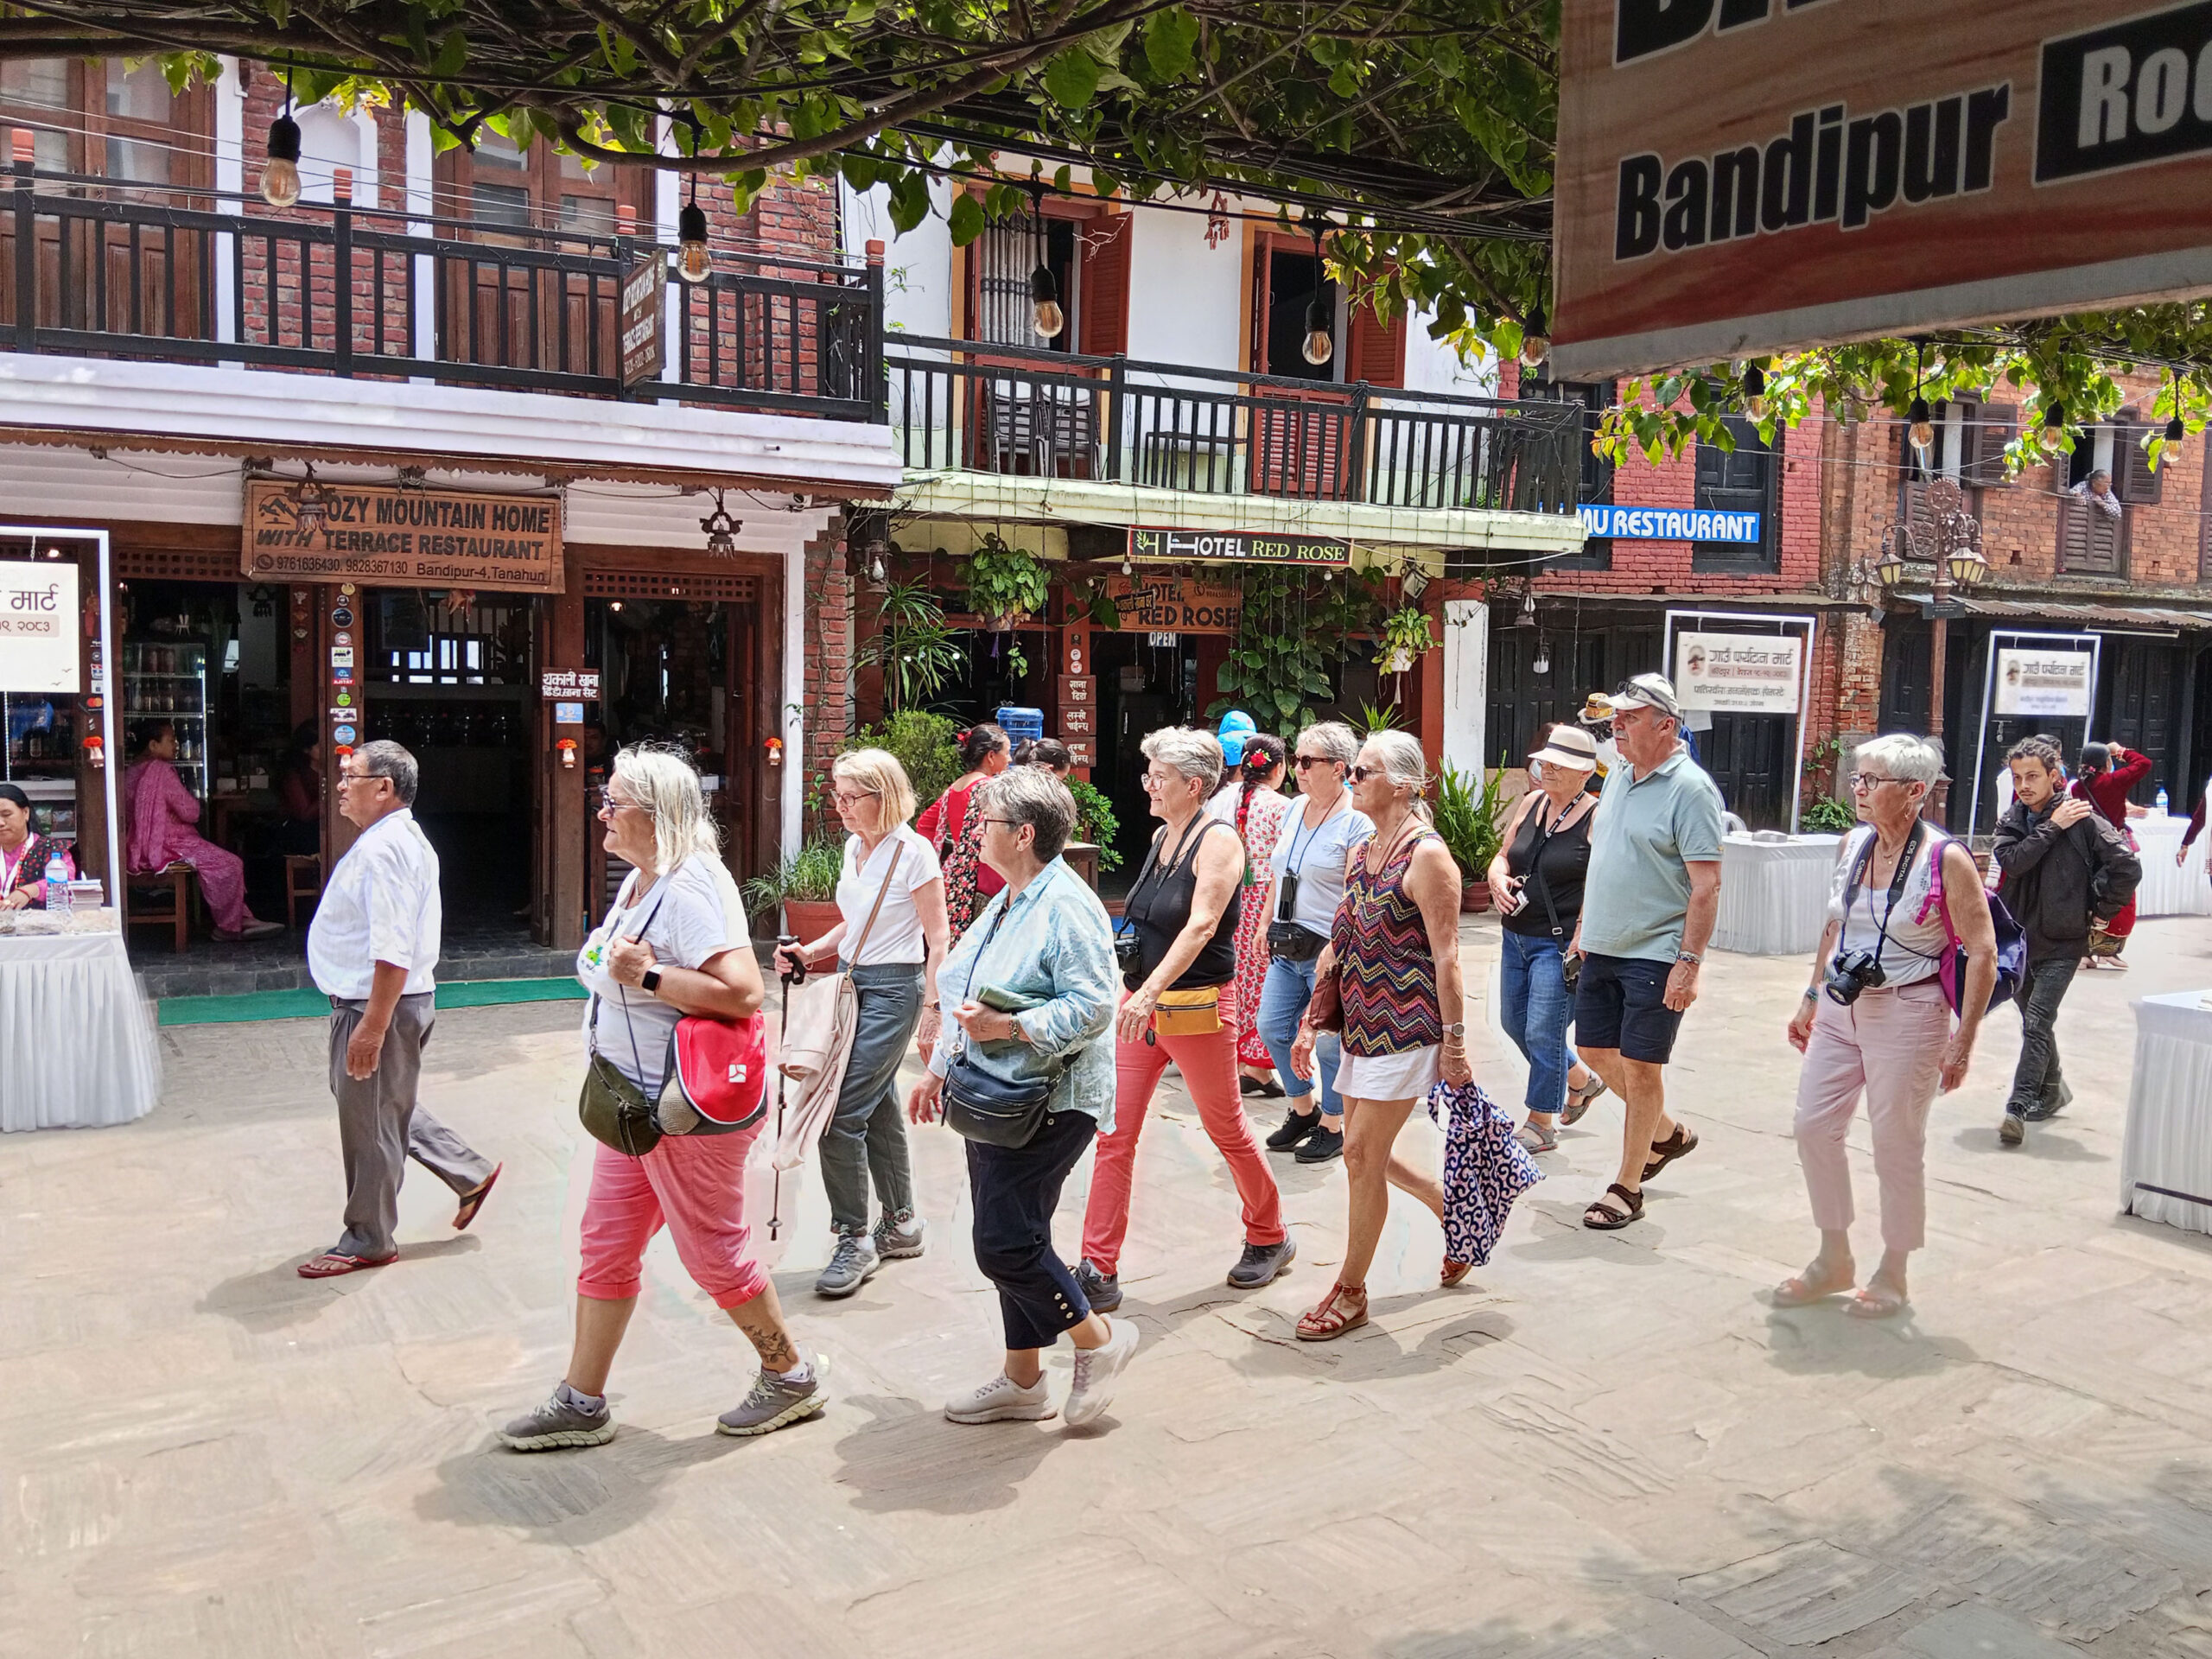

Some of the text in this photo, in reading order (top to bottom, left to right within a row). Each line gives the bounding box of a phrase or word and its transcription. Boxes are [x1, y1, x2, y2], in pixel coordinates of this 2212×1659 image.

[1614, 84, 2010, 261] Bandipur
[316, 493, 550, 533] OZY MOUNTAIN HOME
[1612, 510, 1756, 541] RESTAURANT
[256, 529, 543, 561] WITH TERRACE RESTAURANT
[1166, 532, 1246, 557] HOTEL
[1251, 540, 1290, 558] RED
[1297, 545, 1345, 561] ROSE
[346, 560, 408, 574] 9828367130
[10, 582, 59, 611] मार्ट
[17, 620, 50, 632] २०८३
[1138, 606, 1237, 627] RED ROSE
[1149, 632, 1176, 646] OPEN
[1772, 648, 1794, 666] मार्ट
[1897, 840, 1916, 882] EOS DIGITAL
